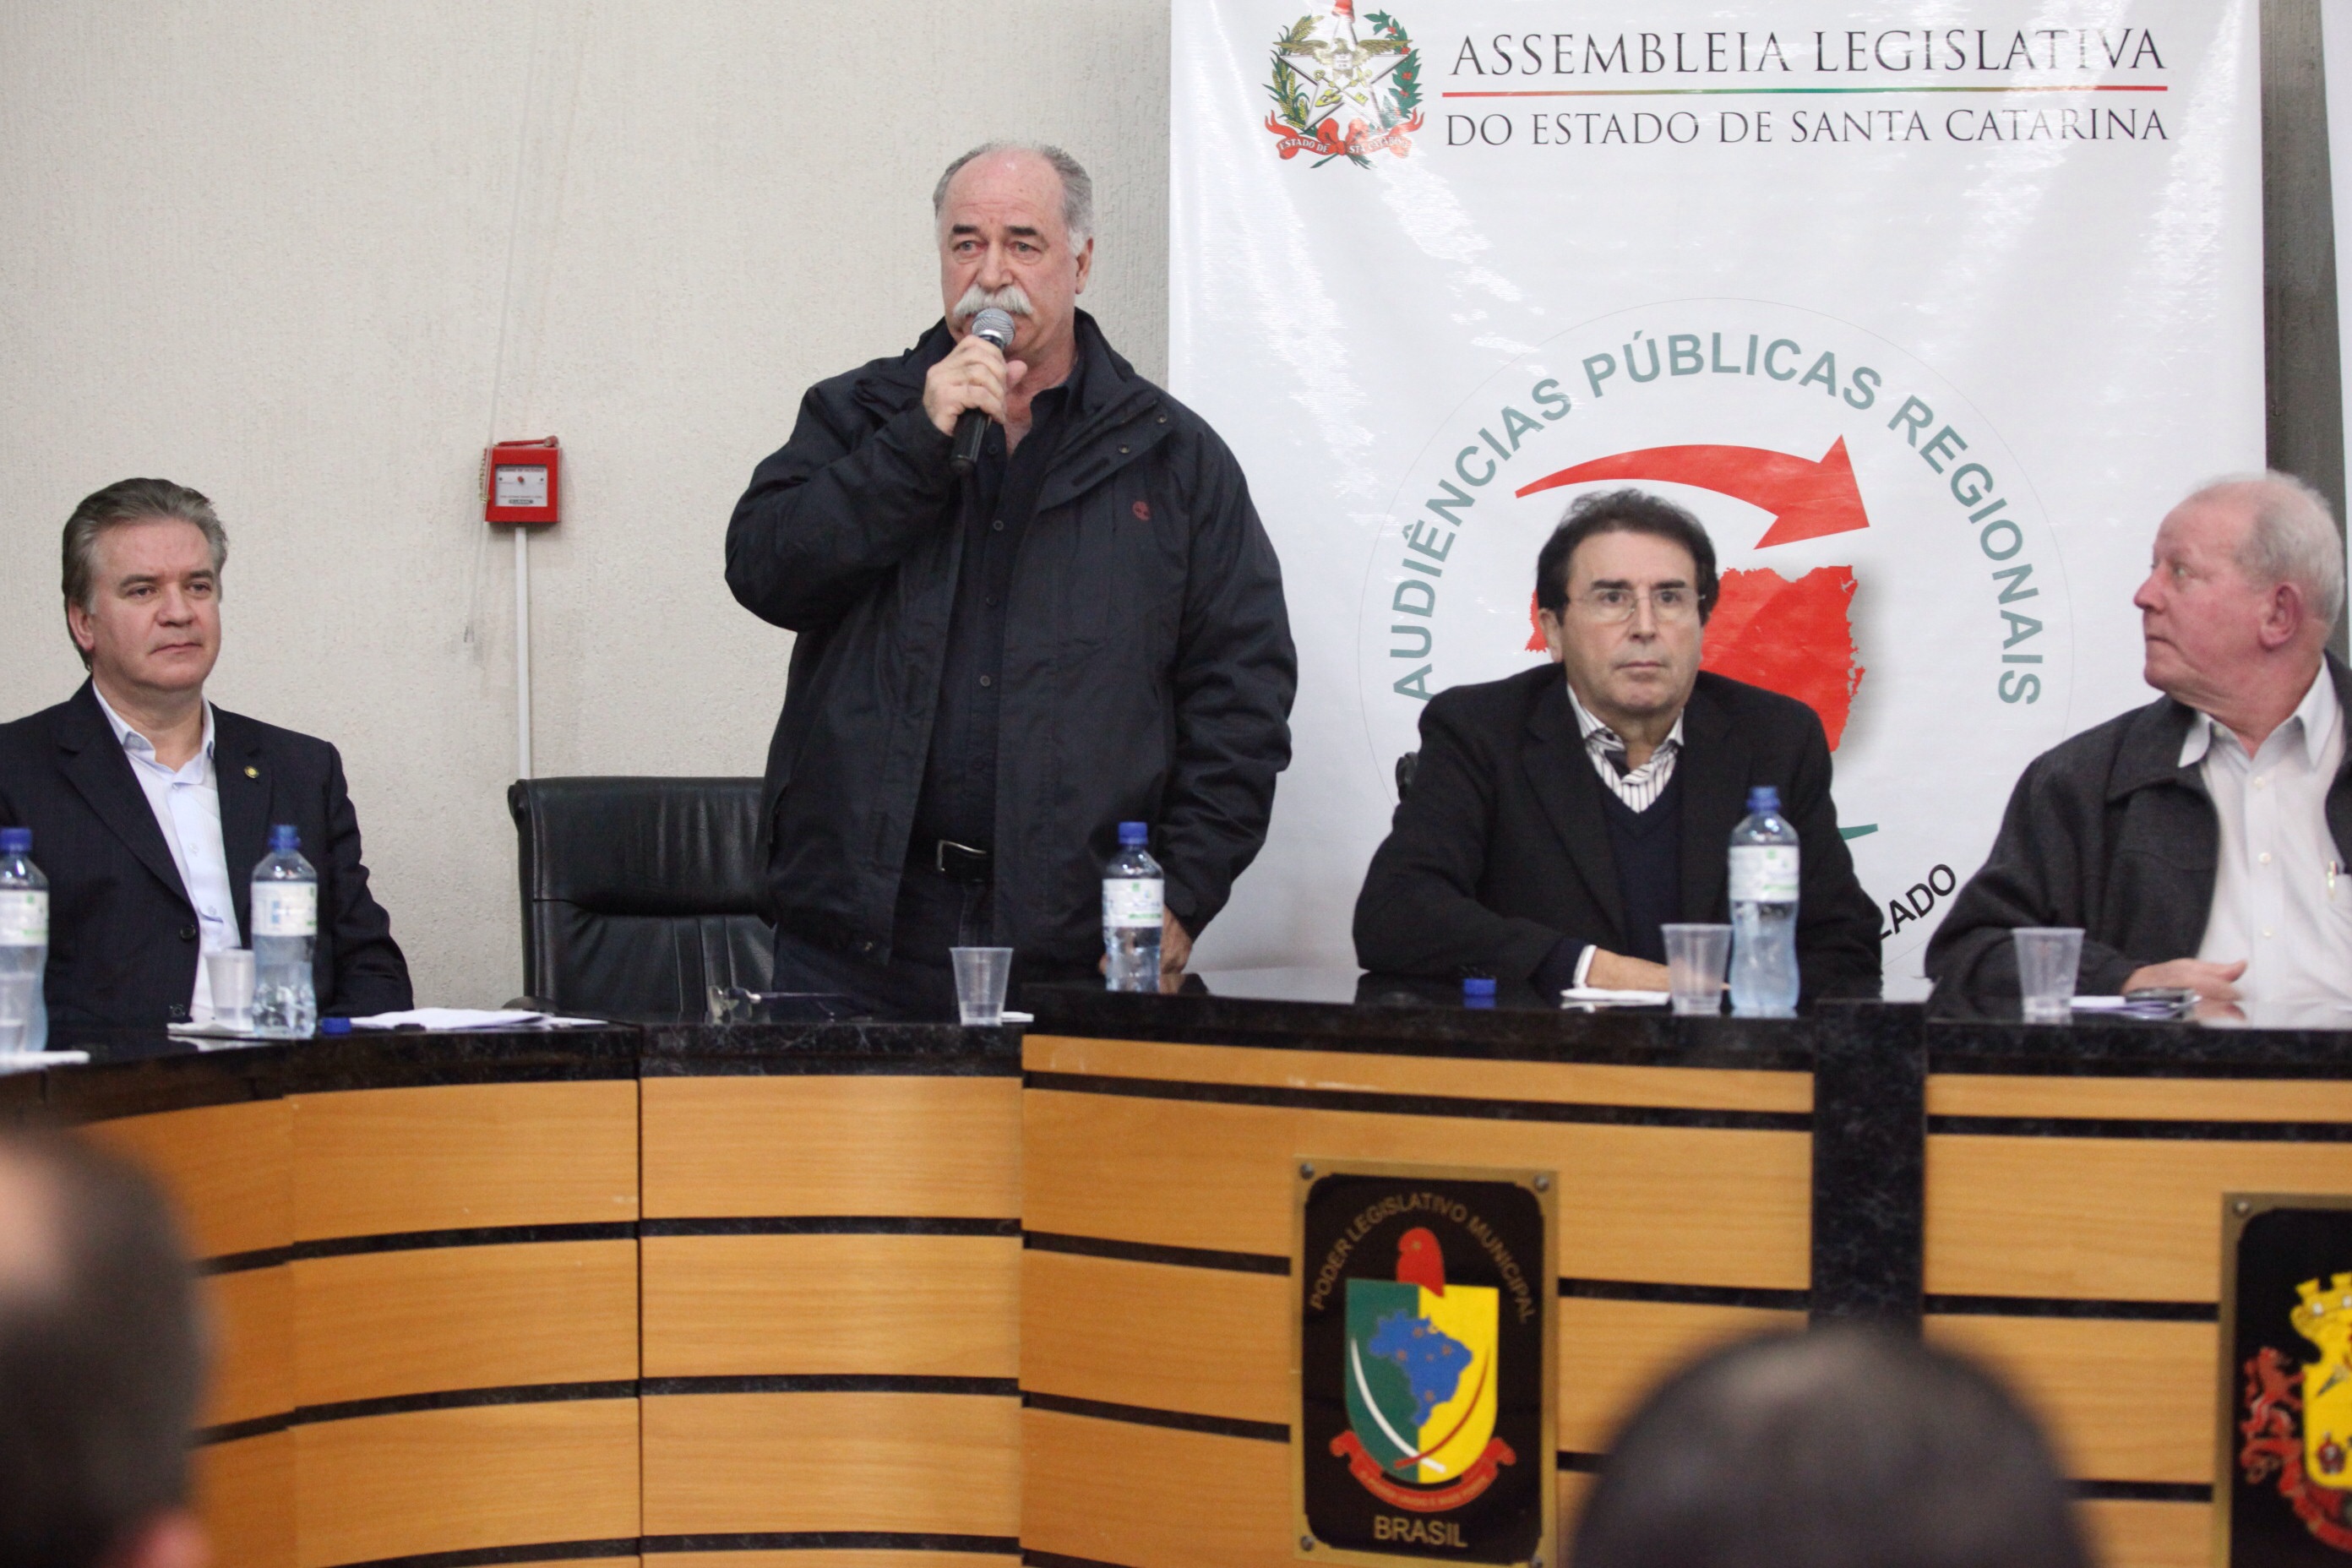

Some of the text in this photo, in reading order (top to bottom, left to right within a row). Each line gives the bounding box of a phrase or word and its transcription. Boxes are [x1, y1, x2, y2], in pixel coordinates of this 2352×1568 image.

[1448, 28, 2168, 76] ASSEMBLEIA LEGISLATIVA
[1278, 138, 1315, 151] ESTADO
[1445, 107, 2170, 146] DO ESTADO DE SANTA CATARINA
[1389, 329, 2044, 706] AUDIÊNCIAS PÚBLICAS REGIONAIS
[1310, 1192, 1536, 1324] PODER LEGISLATIVO MUNICIPAL
[1374, 1514, 1468, 1548] BRASIL
